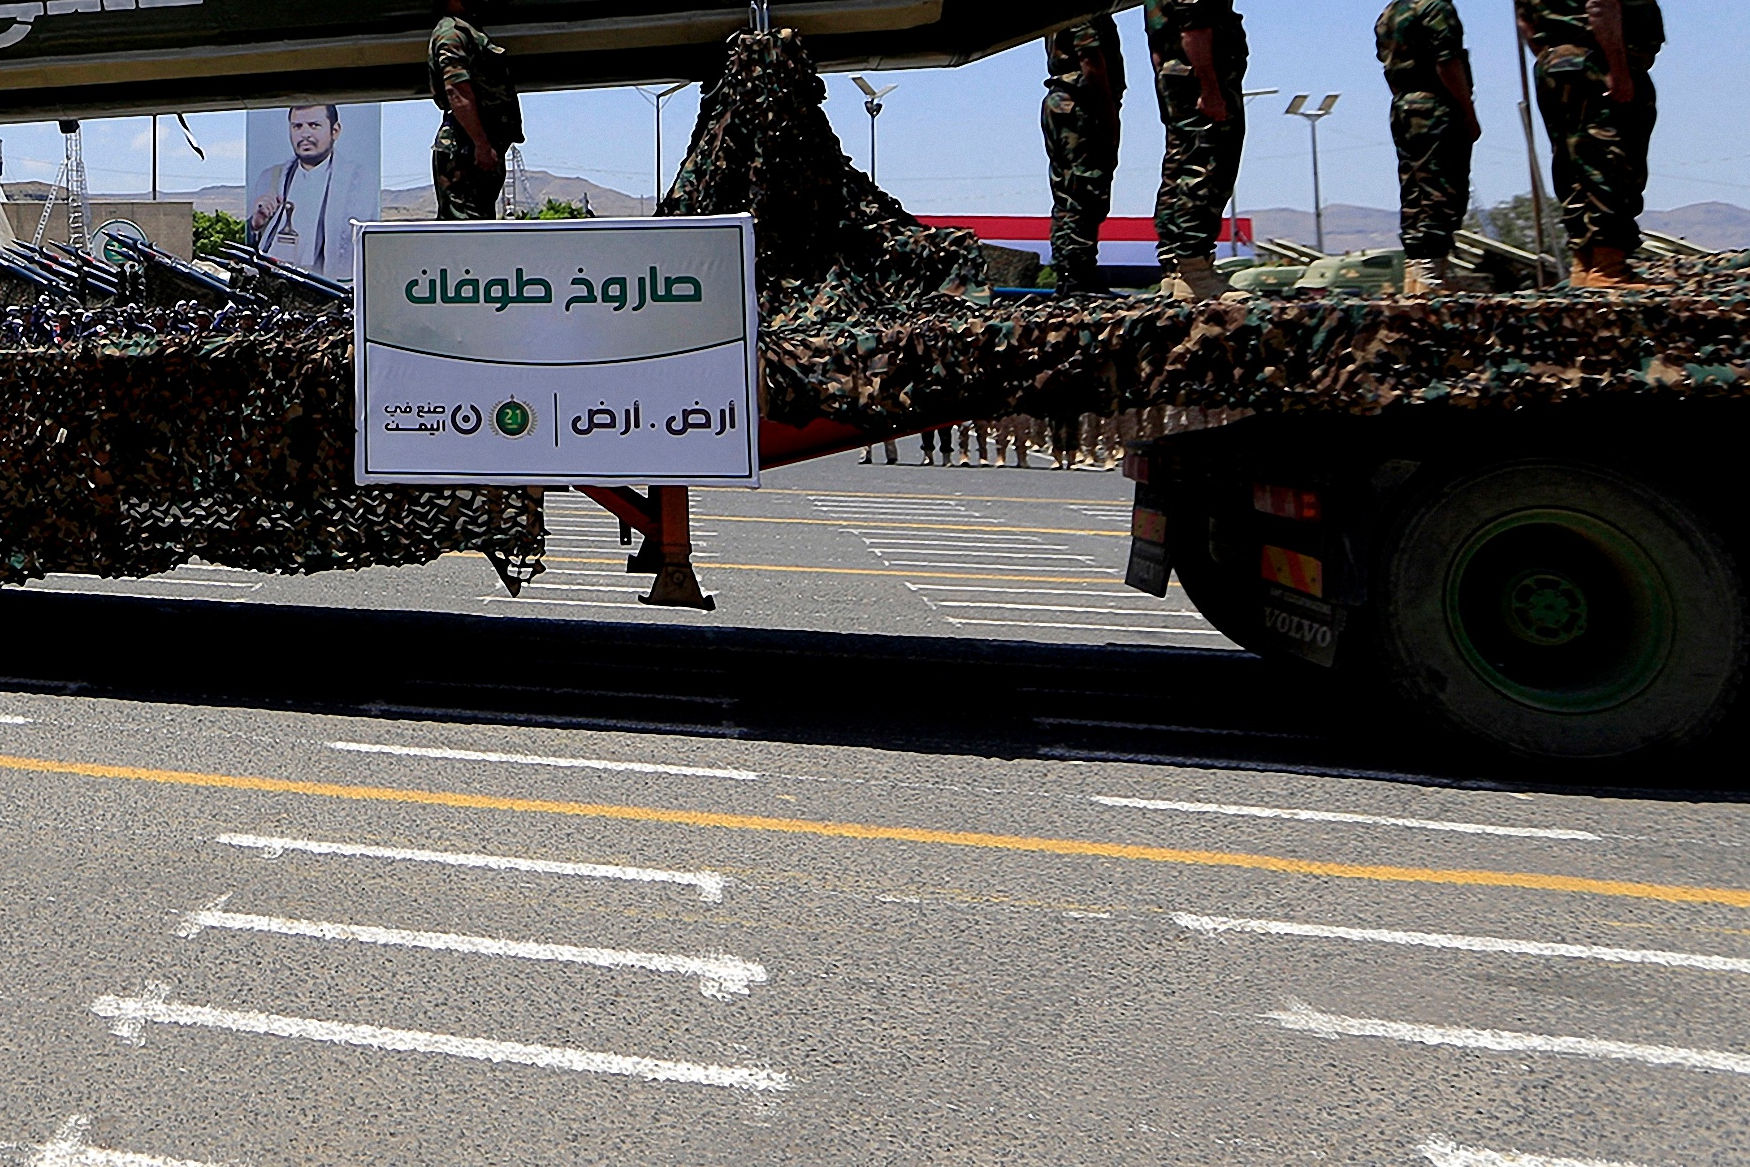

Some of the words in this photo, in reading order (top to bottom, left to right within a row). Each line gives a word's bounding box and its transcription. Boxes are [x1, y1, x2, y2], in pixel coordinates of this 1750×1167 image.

[404, 267, 552, 313] طوفان
[565, 266, 702, 312] صاروخ
[384, 402, 412, 417] في
[384, 419, 446, 436] اليمن
[416, 402, 446, 418] صنع
[504, 409, 522, 423] 21
[571, 400, 640, 436] أرض
[665, 400, 736, 436] أرض
[1262, 606, 1332, 648] VOLVO
